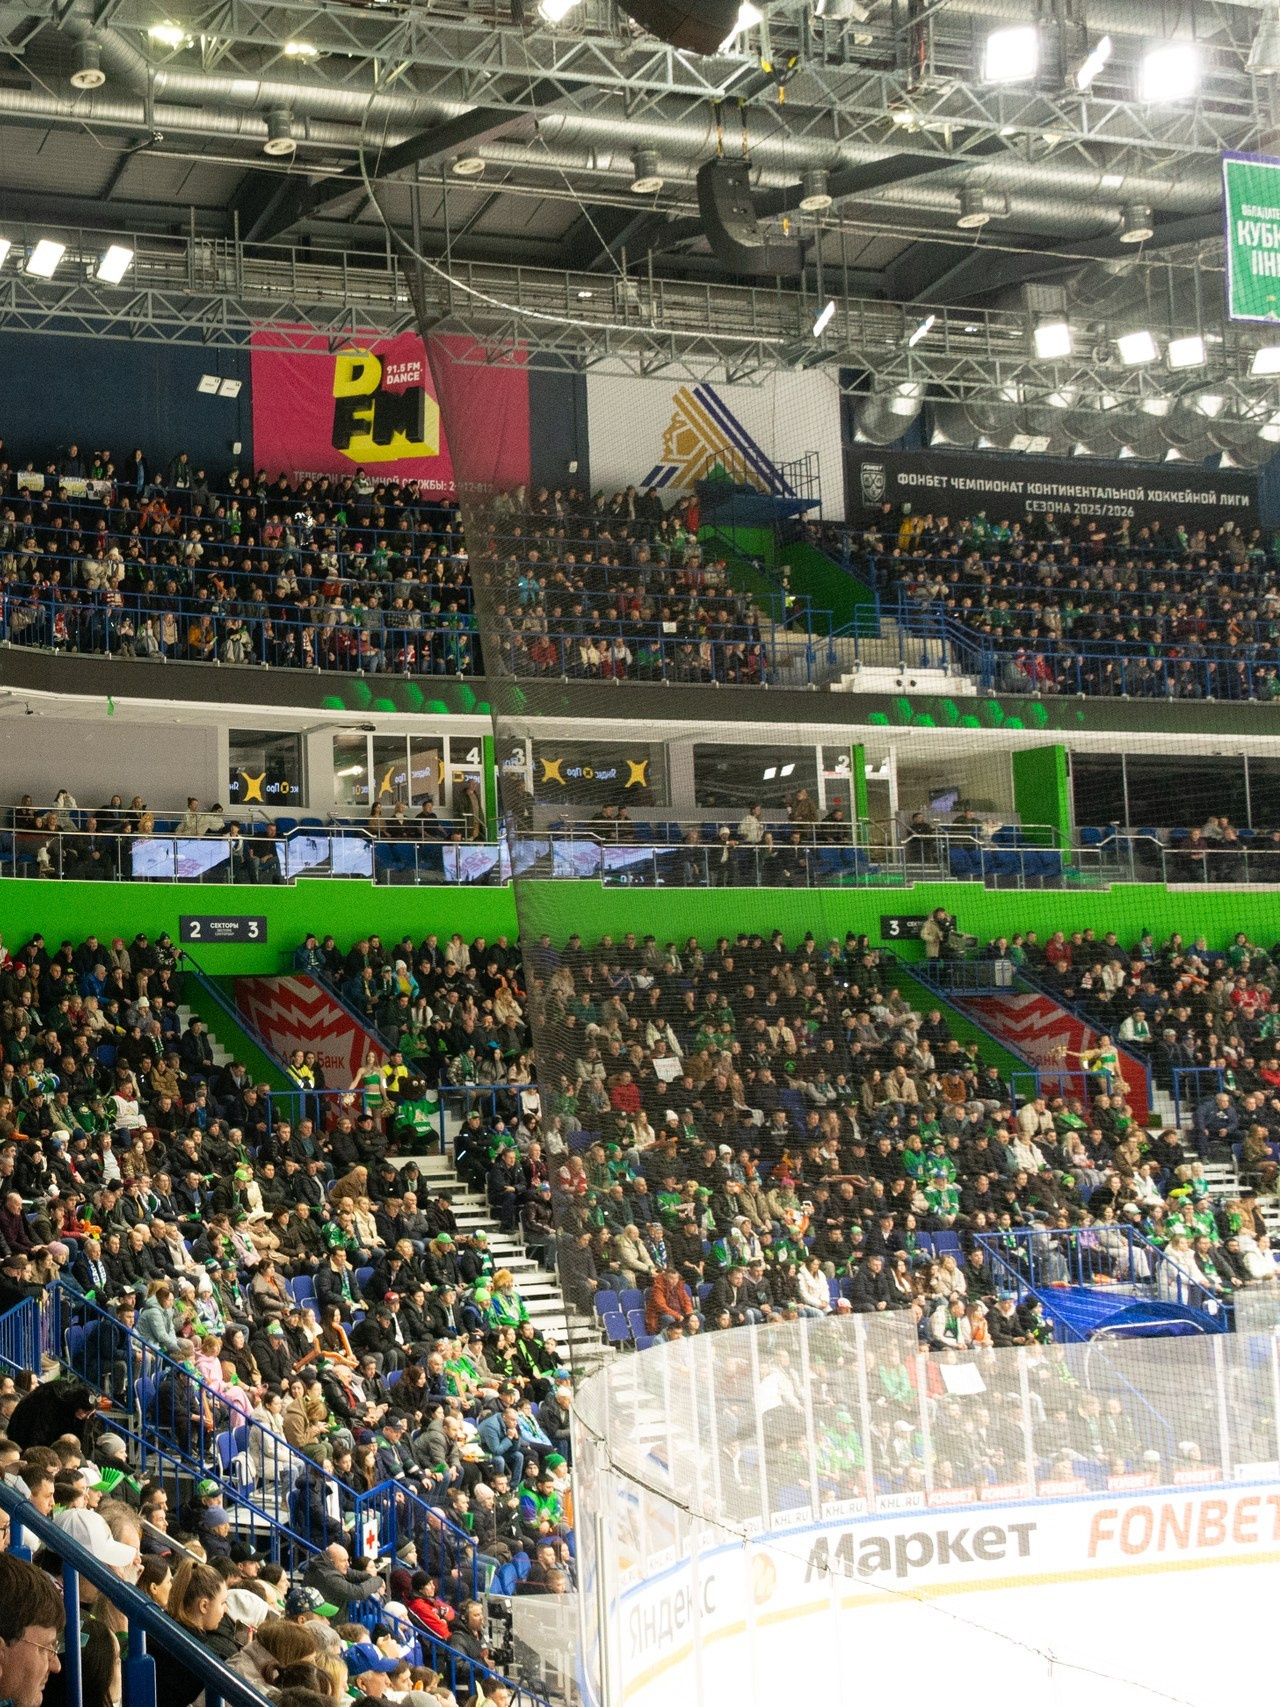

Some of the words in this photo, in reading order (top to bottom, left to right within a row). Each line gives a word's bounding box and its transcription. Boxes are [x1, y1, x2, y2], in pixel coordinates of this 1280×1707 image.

[386, 363, 406, 375] 91.5
[386, 372, 421, 385] DANCE
[897, 472, 949, 488] ФОНБЕТ
[950, 477, 1024, 494] ЧЕМПИОНАТ
[1026, 482, 1145, 502] КОНТИНЕНТАЛЬНОЙ
[1147, 489, 1217, 505] ХОККЕЙНОЙ
[1219, 494, 1251, 507] ЛИГИ
[1025, 499, 1071, 514] СЕЗОНА
[1073, 502, 1136, 518] 2025/2026
[466, 747, 481, 765] 4
[511, 748, 526, 766] 3
[836, 755, 851, 773] 2
[189, 921, 201, 938] 2
[247, 921, 259, 938] 3
[889, 920, 900, 936] 3
[318, 1052, 345, 1069] Банк
[825, 1502, 864, 1518] KHL.RU
[879, 1496, 921, 1510] KHL.RU
[773, 1510, 809, 1528] KHL.RU
[803, 1521, 1038, 1584] Маркет
